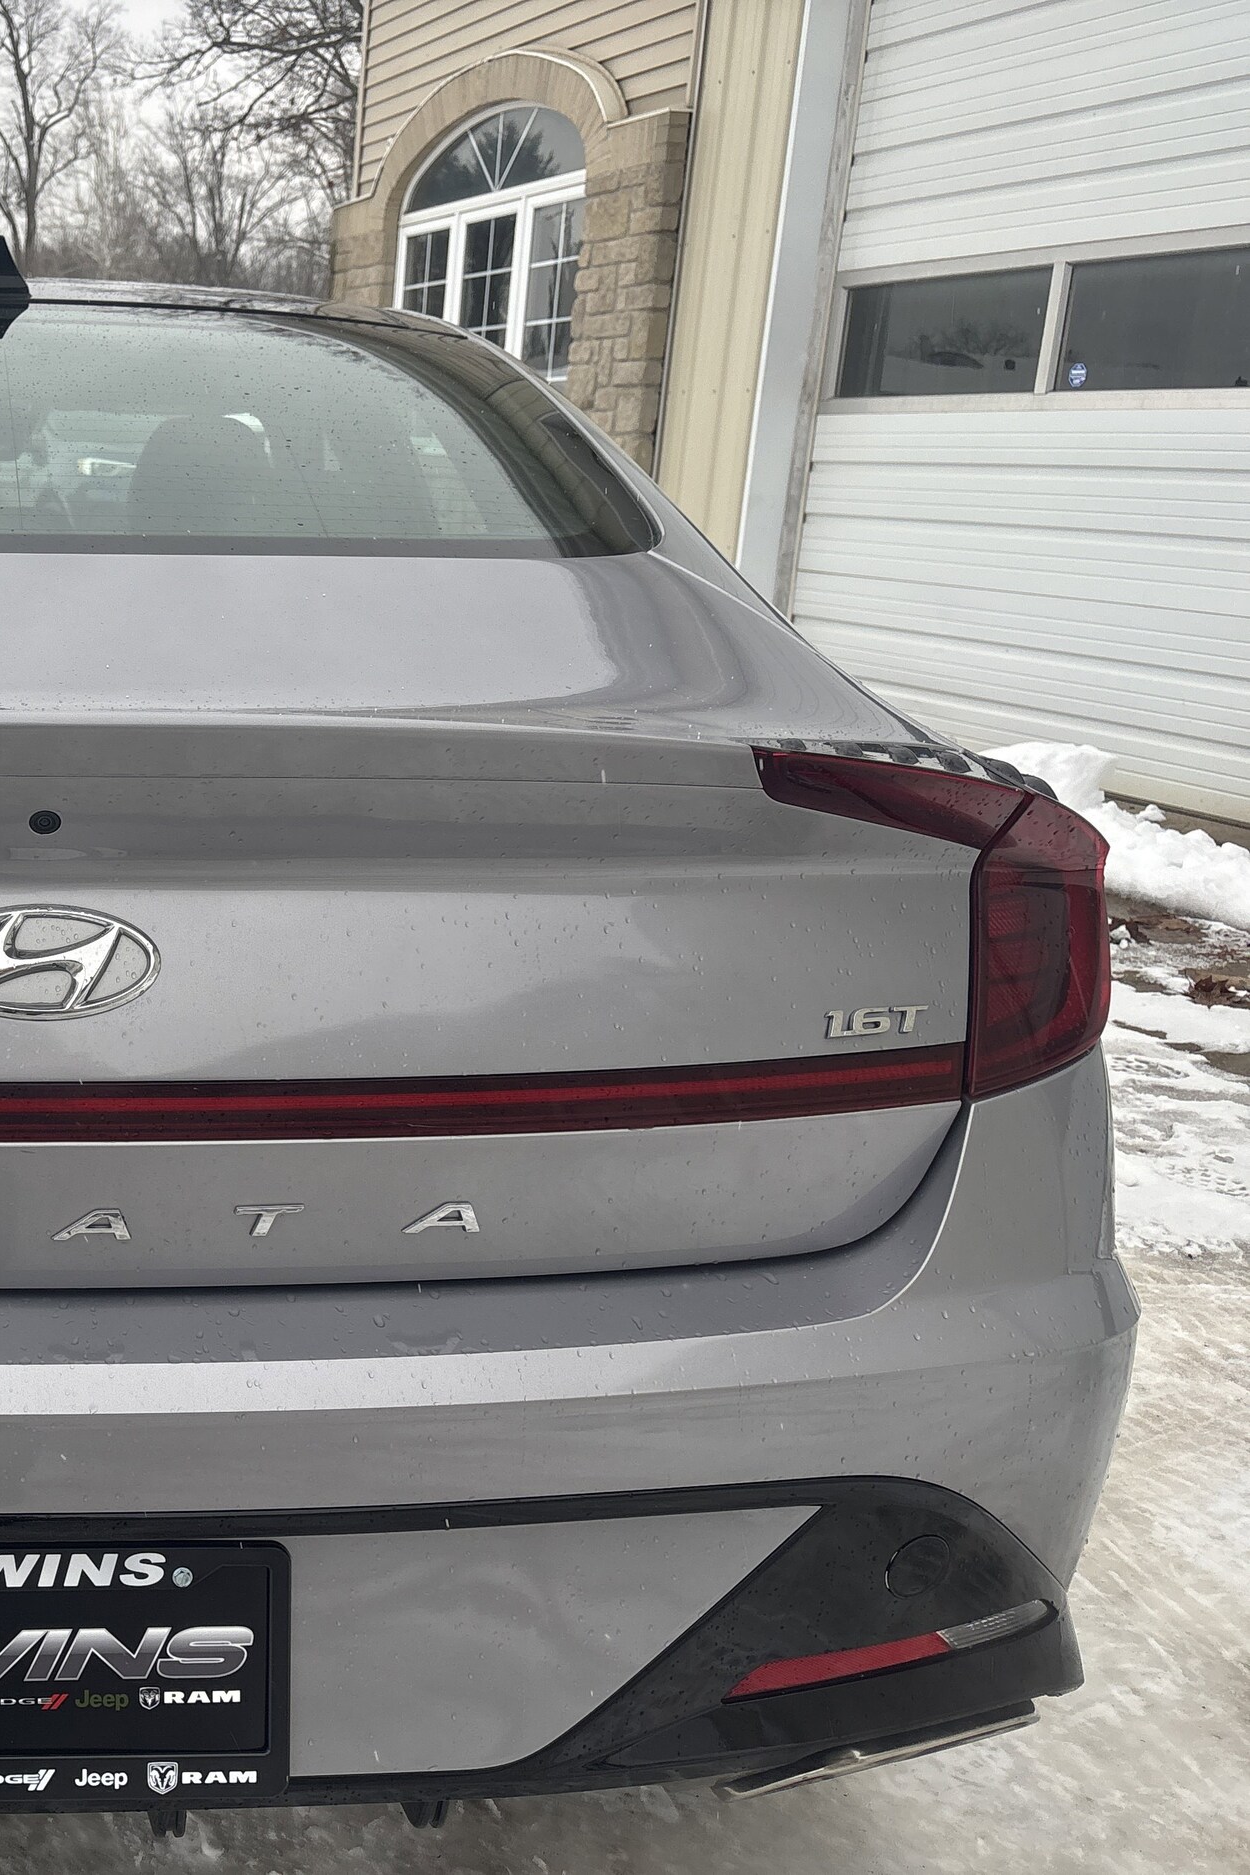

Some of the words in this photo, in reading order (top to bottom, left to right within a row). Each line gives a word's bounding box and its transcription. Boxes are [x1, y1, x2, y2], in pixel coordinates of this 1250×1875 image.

[75, 1689, 129, 1711] Jeep
[163, 1689, 241, 1704] RAM
[74, 1768, 128, 1789] Jeep
[181, 1770, 258, 1785] RAM
